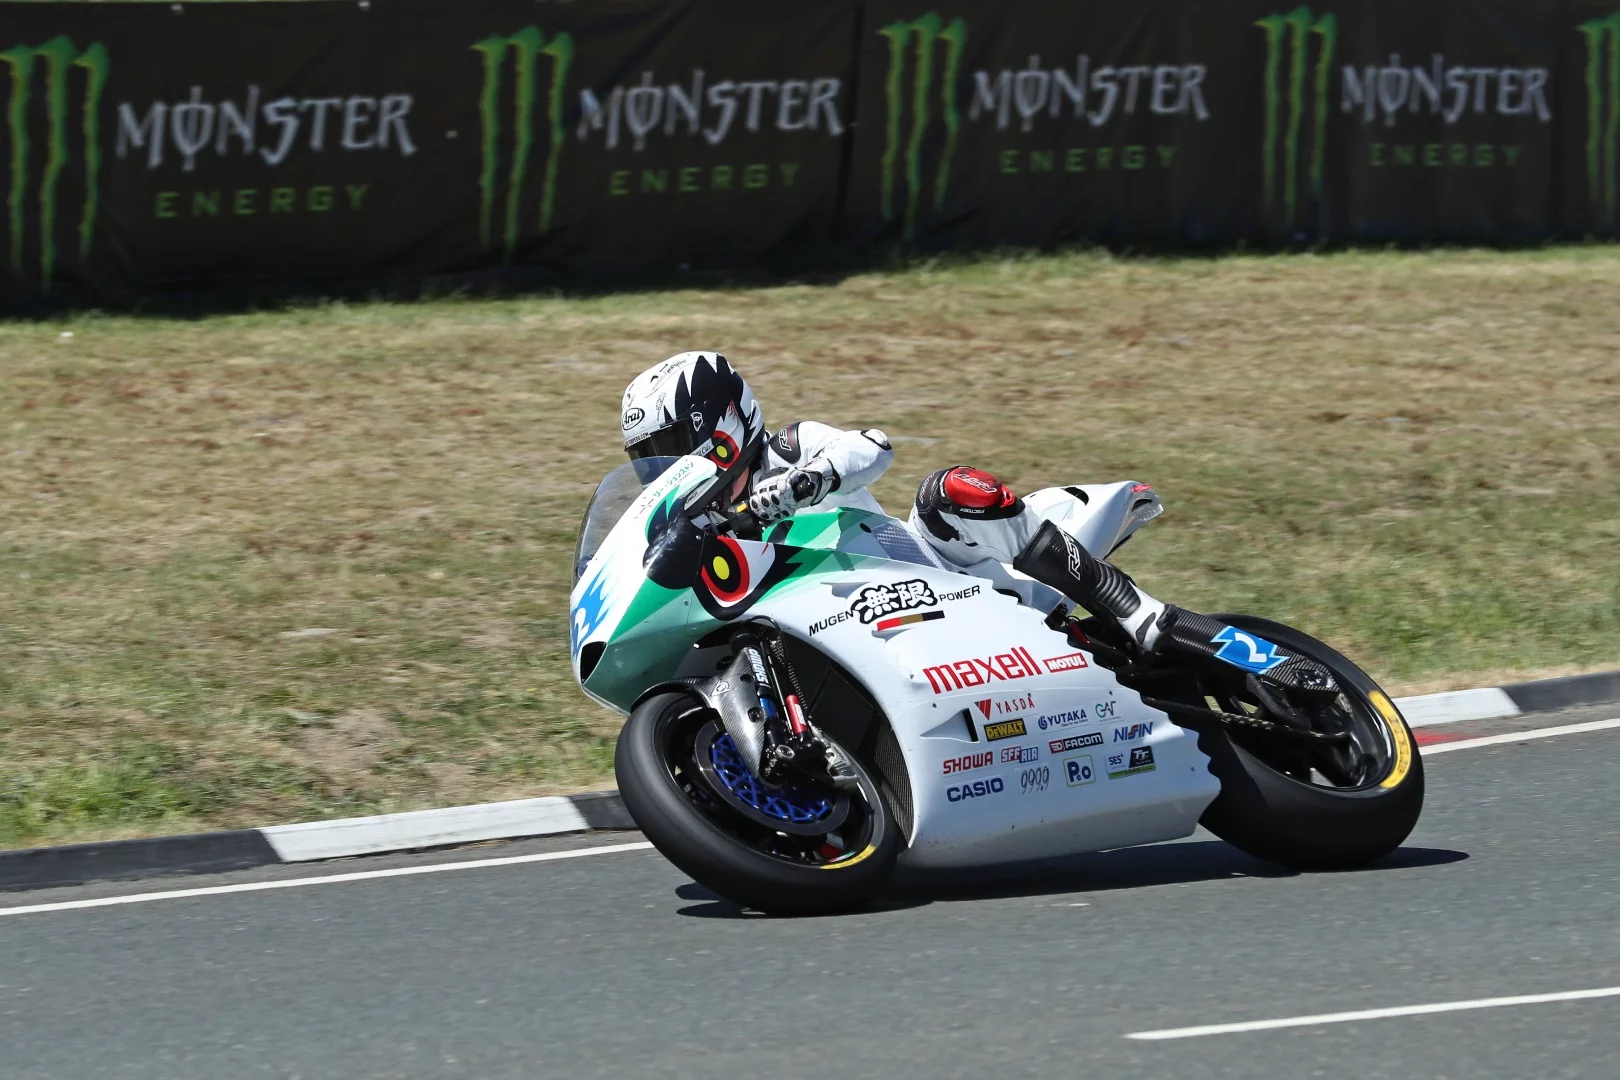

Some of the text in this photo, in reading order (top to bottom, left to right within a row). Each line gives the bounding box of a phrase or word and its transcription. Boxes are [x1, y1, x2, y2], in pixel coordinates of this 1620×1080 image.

[968, 53, 1212, 132] MONSTER
[1341, 53, 1553, 127] MONSTER
[576, 69, 845, 151] MONSTER
[115, 84, 417, 172] MONSTER
[1001, 144, 1178, 174] ENERGY
[1369, 142, 1522, 167] ENERGY
[609, 162, 800, 195] ENERGY
[154, 183, 370, 218] ENERGY
[808, 578, 981, 637] MUGEN 無限 POWER
[1234, 632, 1267, 663] 2
[922, 646, 1043, 694] maxell
[1046, 654, 1087, 671] MOTUL
[995, 696, 1035, 715] YASDA
[1047, 709, 1087, 726] YUTAKA
[1001, 747, 1038, 763] SFF AIR
[1064, 734, 1103, 749] FACOM
[1134, 749, 1149, 760] TT
[943, 751, 994, 775] SHOWA
[1108, 755, 1122, 766] SES
[946, 777, 1004, 803] CASIO
